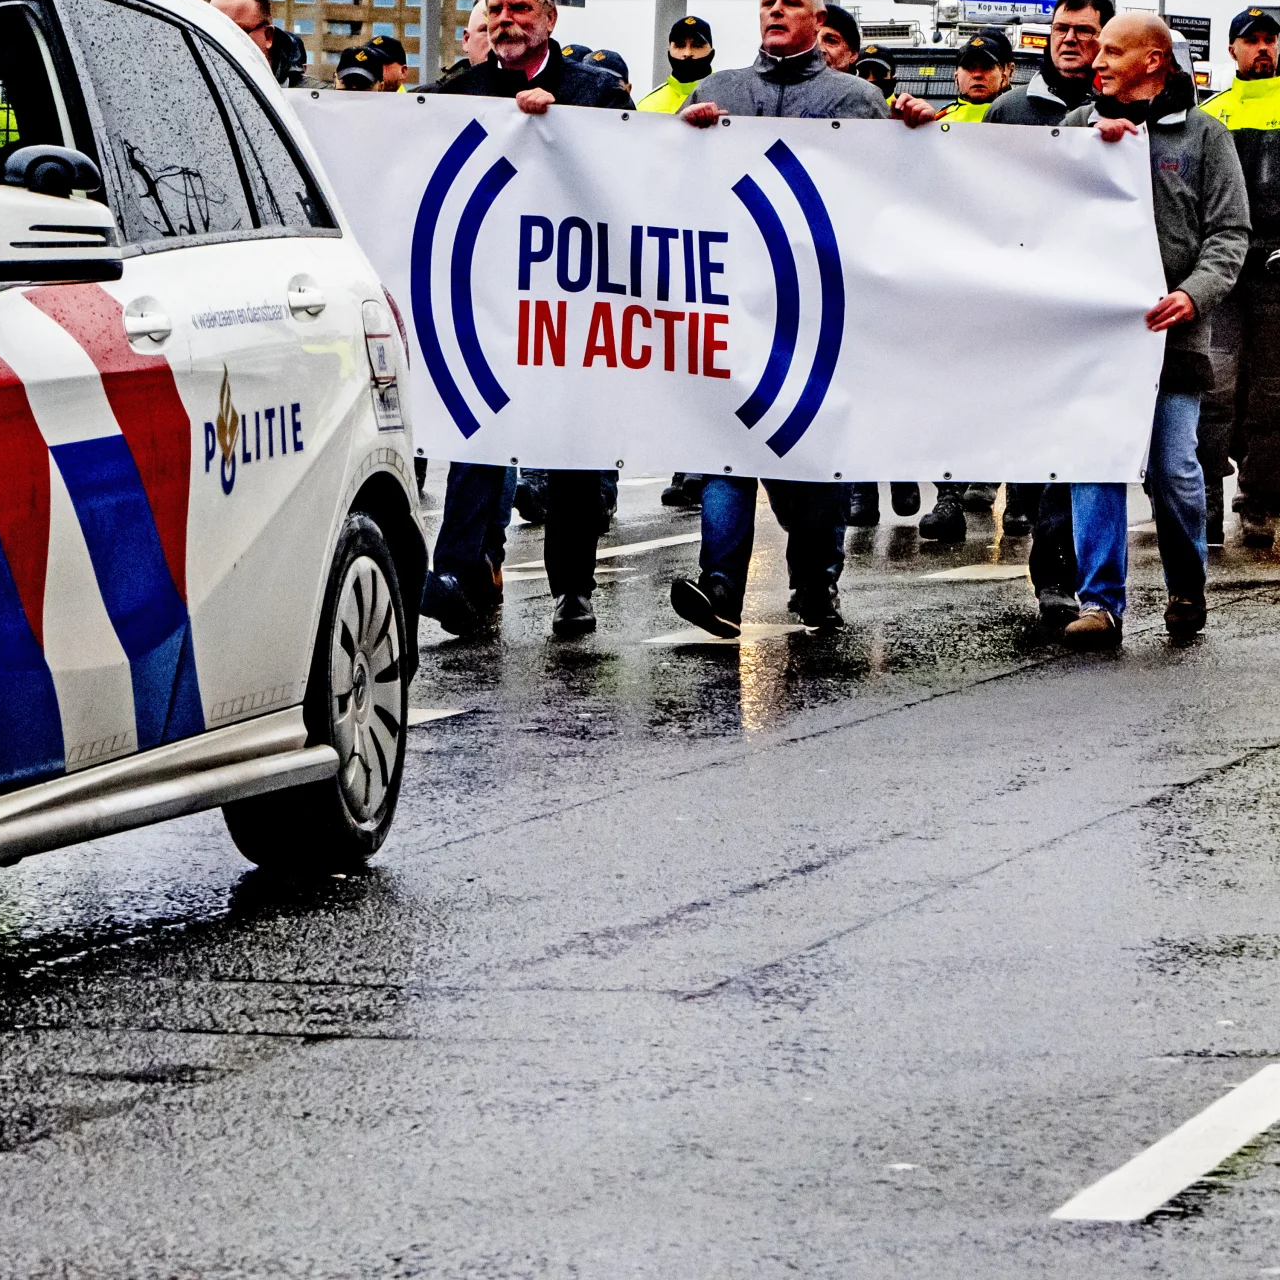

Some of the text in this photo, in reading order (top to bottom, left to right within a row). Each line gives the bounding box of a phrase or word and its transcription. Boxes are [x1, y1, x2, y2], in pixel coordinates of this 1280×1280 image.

[978, 3, 992, 11] Kop
[1010, 4, 1027, 13] Zuid
[518, 215, 729, 306] POLITIE
[198, 305, 238, 329] waakzaam
[246, 299, 283, 323] dienstbaar
[517, 300, 731, 380] IN ACTIE
[204, 403, 304, 496] POLITIE
